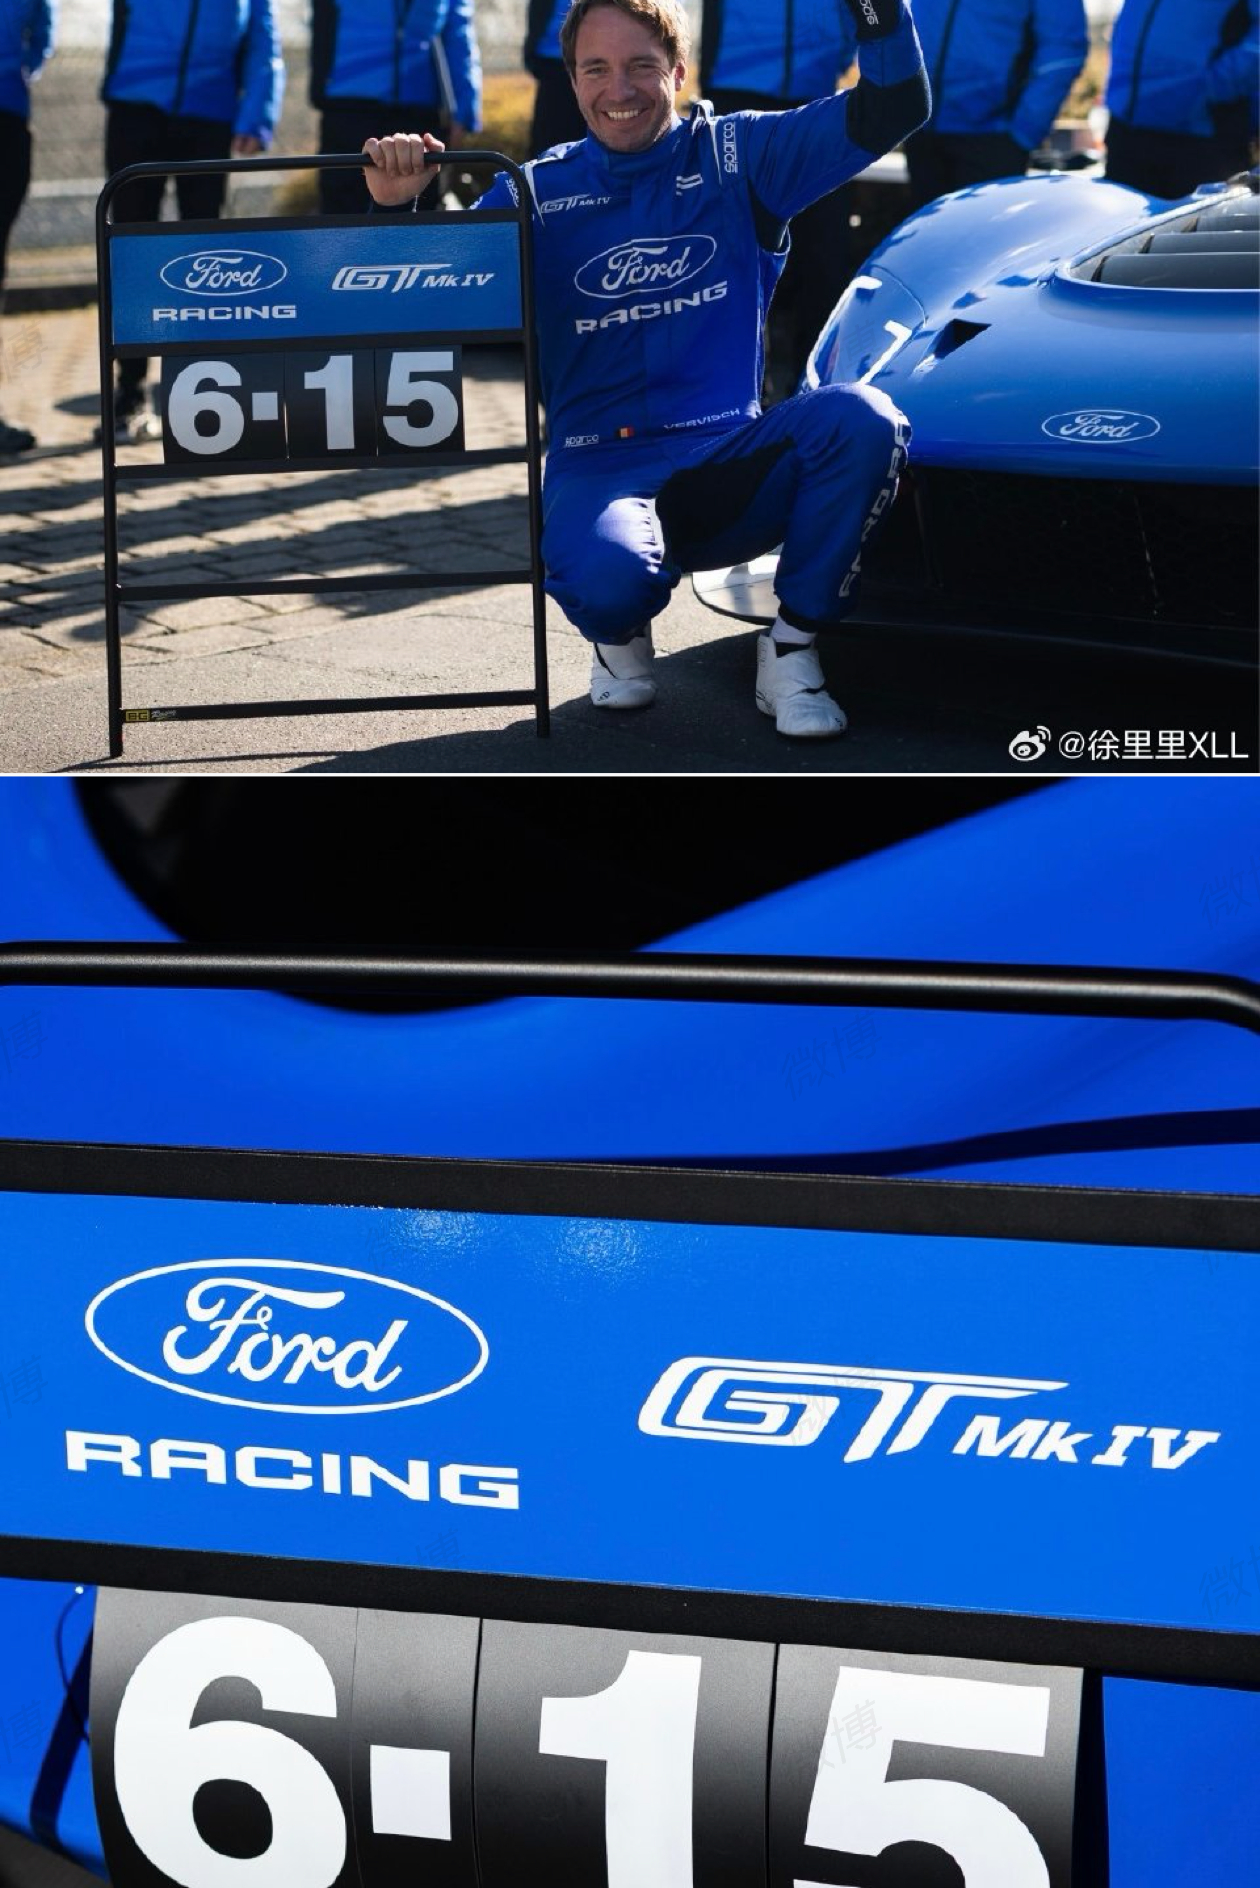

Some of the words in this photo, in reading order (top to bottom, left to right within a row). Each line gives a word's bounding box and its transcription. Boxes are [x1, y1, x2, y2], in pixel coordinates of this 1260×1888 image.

[723, 121, 739, 174] sparco
[185, 256, 262, 289] Ford
[331, 263, 454, 294] GT
[602, 245, 692, 291] Ford
[152, 304, 297, 322] RACING
[575, 279, 729, 335] RACING
[663, 408, 741, 430] VERVISCH
[1060, 413, 1140, 438] Ford
[162, 1277, 409, 1393] Ford
[638, 1356, 1070, 1464] GT
[65, 1430, 520, 1510] RACING
